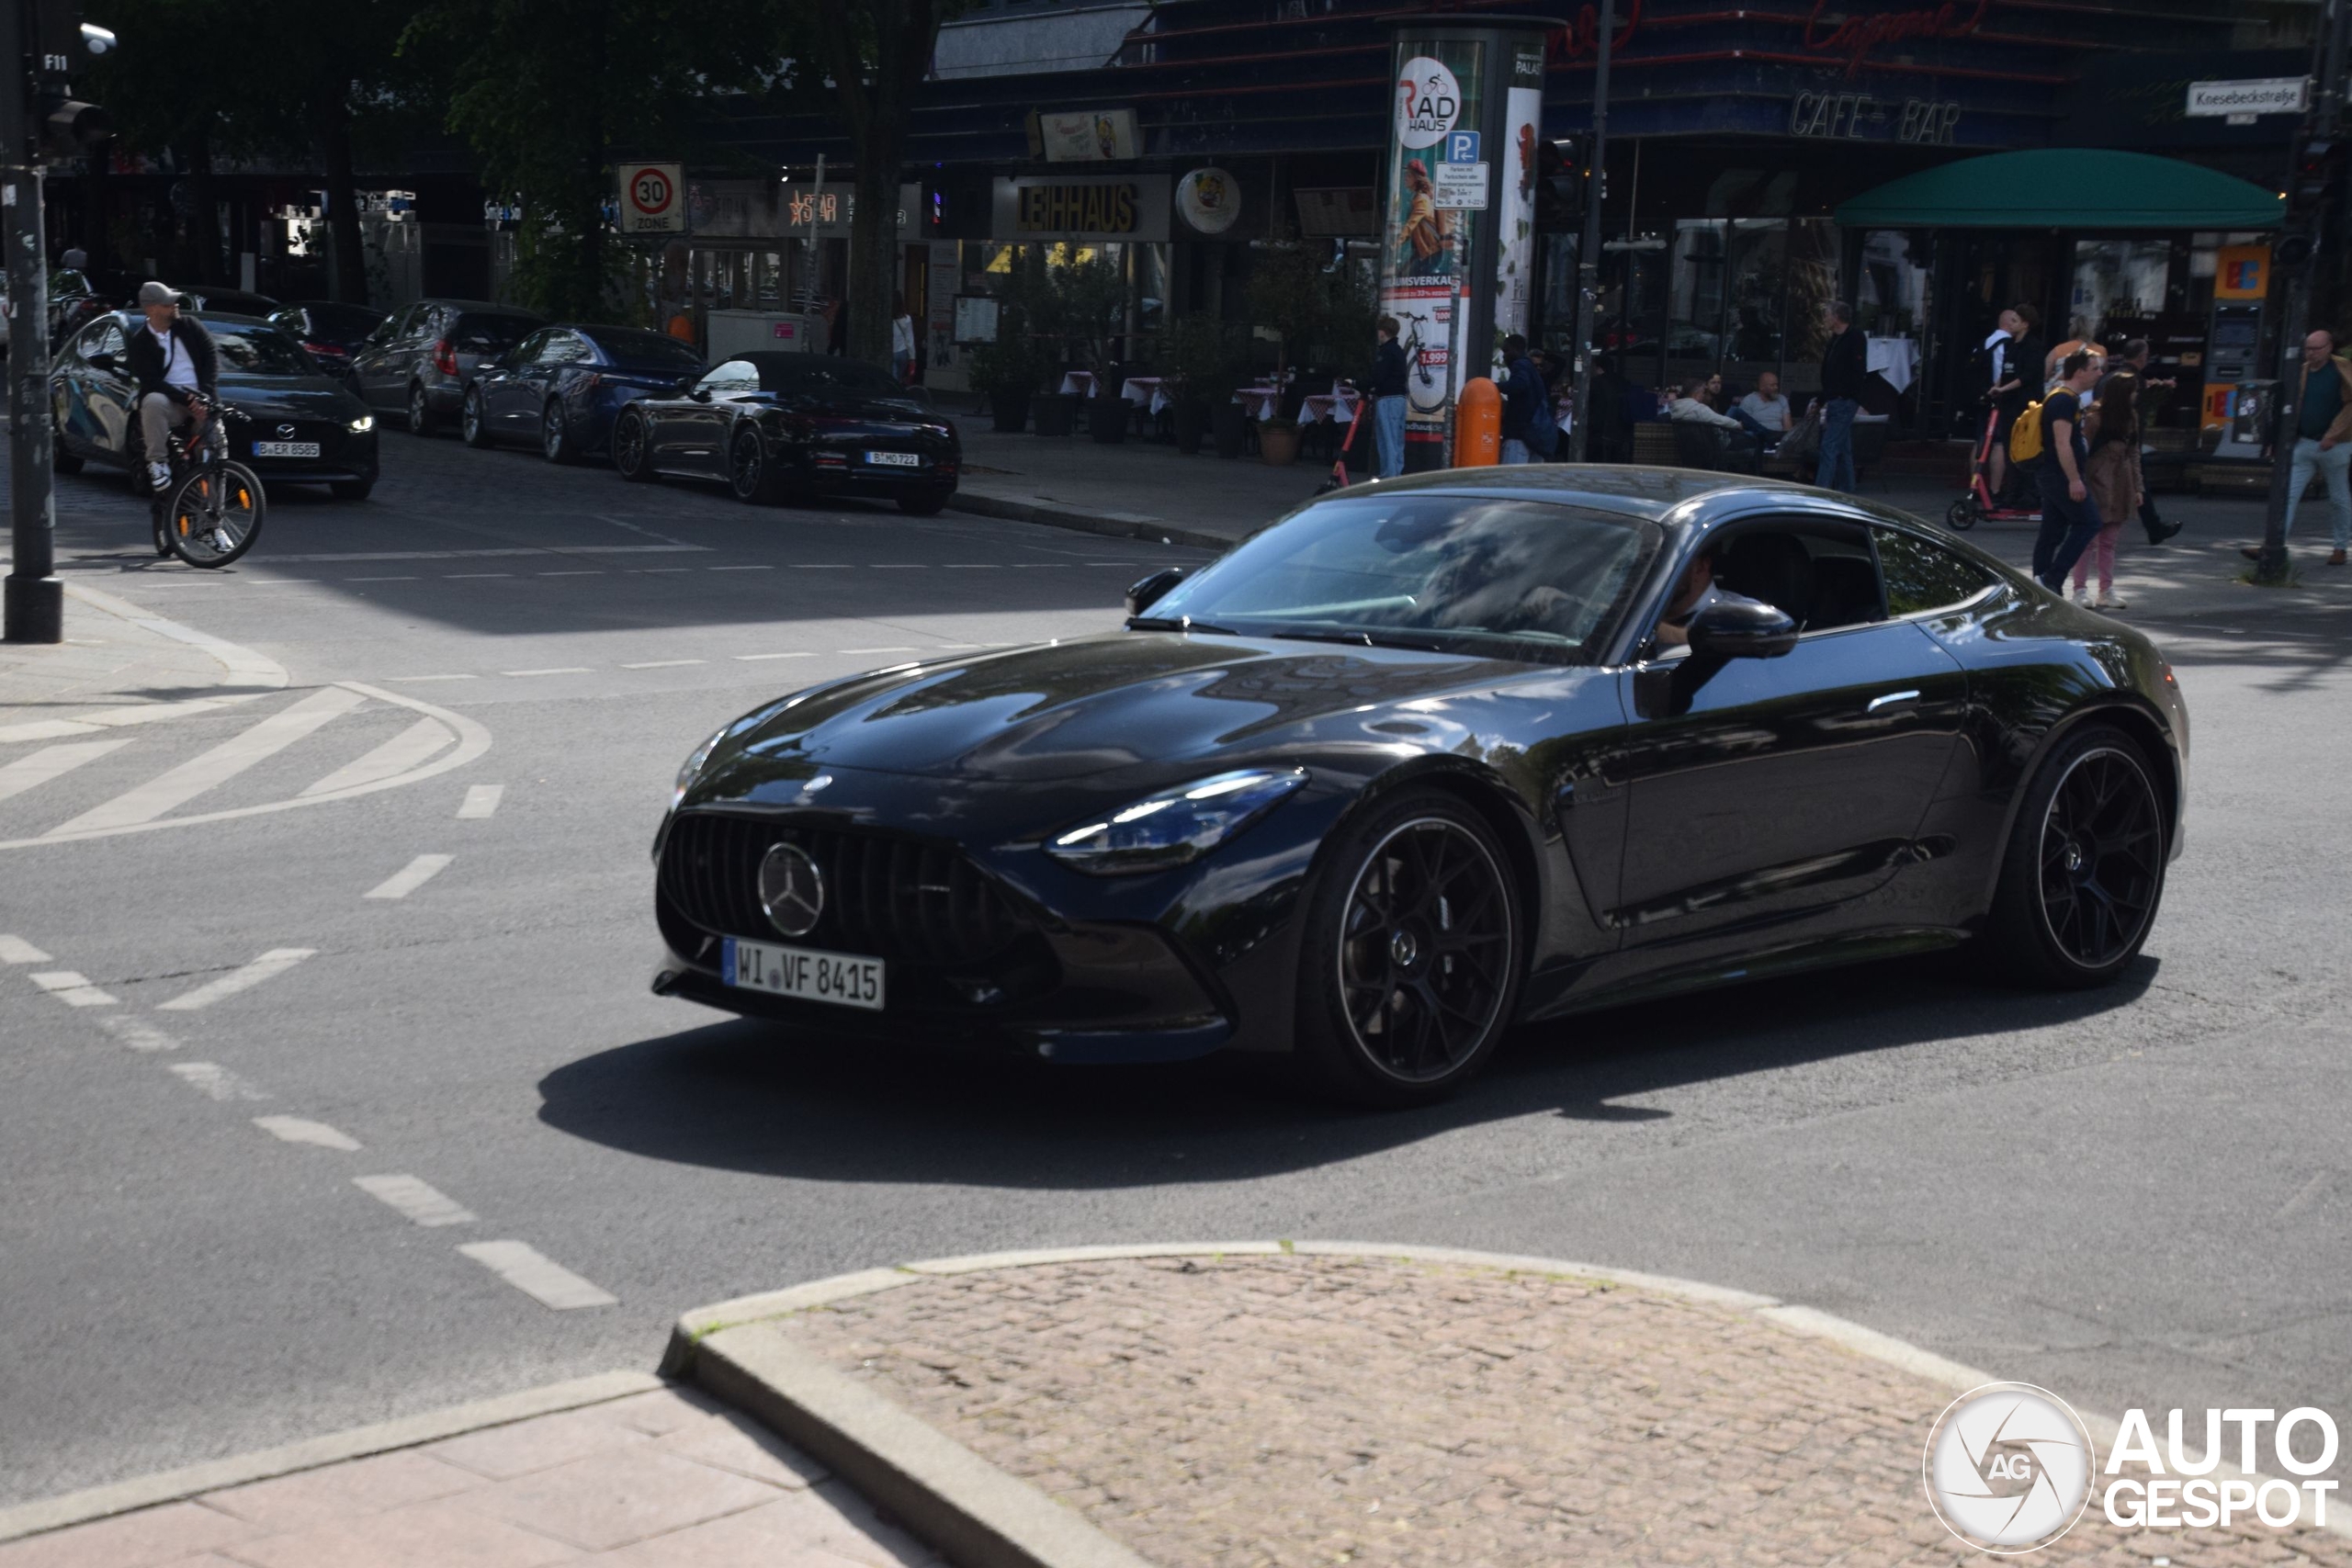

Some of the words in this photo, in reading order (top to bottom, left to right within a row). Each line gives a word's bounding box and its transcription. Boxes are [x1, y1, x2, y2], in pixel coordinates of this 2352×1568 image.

[44, 53, 67, 72] F11
[1399, 80, 1455, 118] RAD
[2196, 88, 2297, 107] Knesebeckstraße
[1409, 119, 1446, 131] HAUS
[1896, 96, 1961, 145] BAR
[1453, 135, 1472, 161] P
[639, 181, 664, 202] 30
[1016, 185, 1136, 231] LEIHHAUS
[637, 217, 669, 230] ZONE
[1406, 423, 1442, 432] adhaus.de
[260, 444, 266, 455] B
[274, 445, 289, 455] ER
[874, 453, 880, 462] B
[899, 455, 915, 465] 722
[739, 946, 763, 985] WI
[783, 953, 809, 992] VF
[818, 958, 876, 1001] 8415
